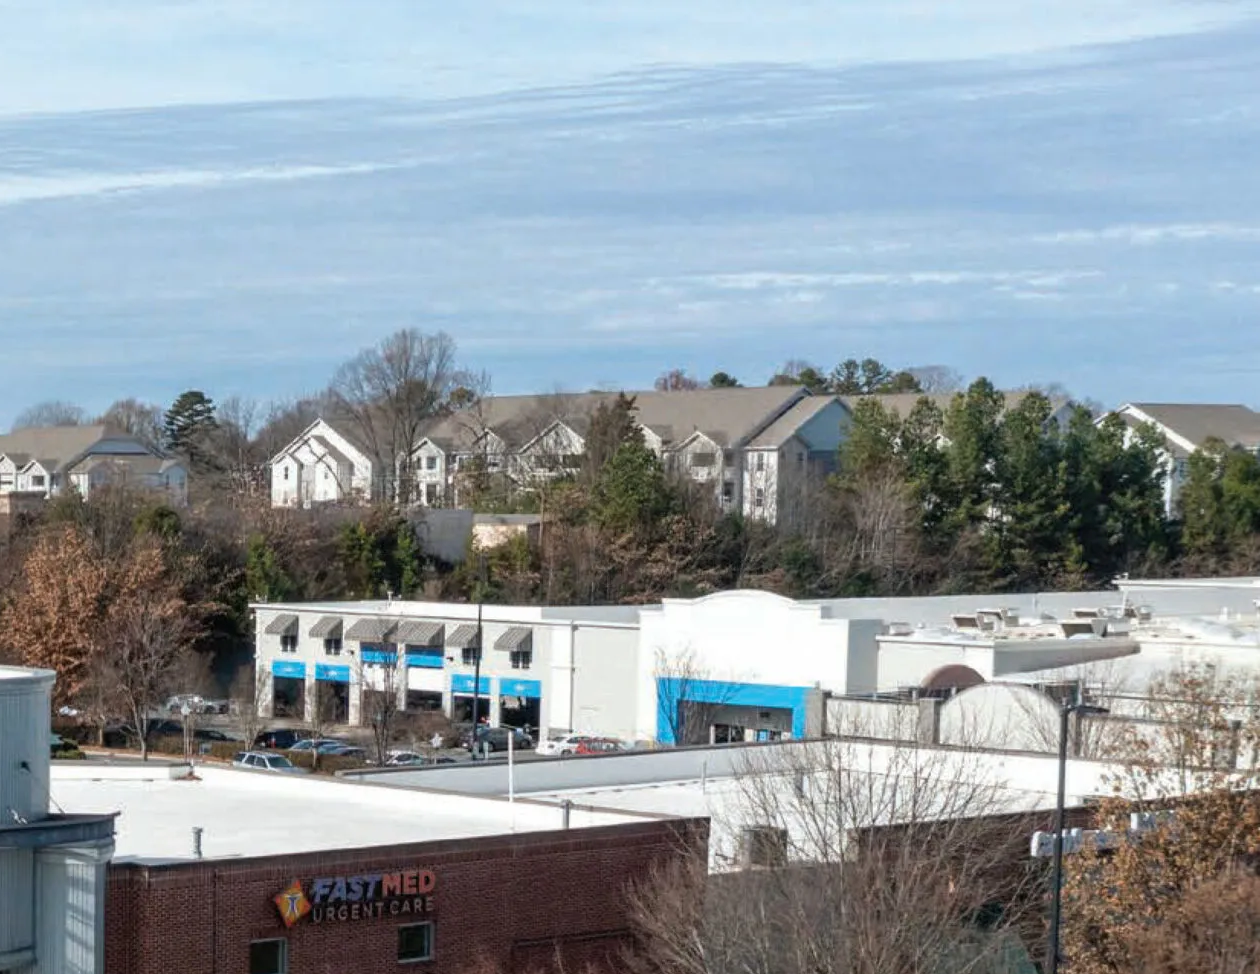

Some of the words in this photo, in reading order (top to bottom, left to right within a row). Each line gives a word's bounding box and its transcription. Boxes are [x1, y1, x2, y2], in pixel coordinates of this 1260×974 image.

[311, 869, 436, 904] FASTMED
[312, 902, 385, 923] URGENT
[391, 897, 434, 915] CARE
